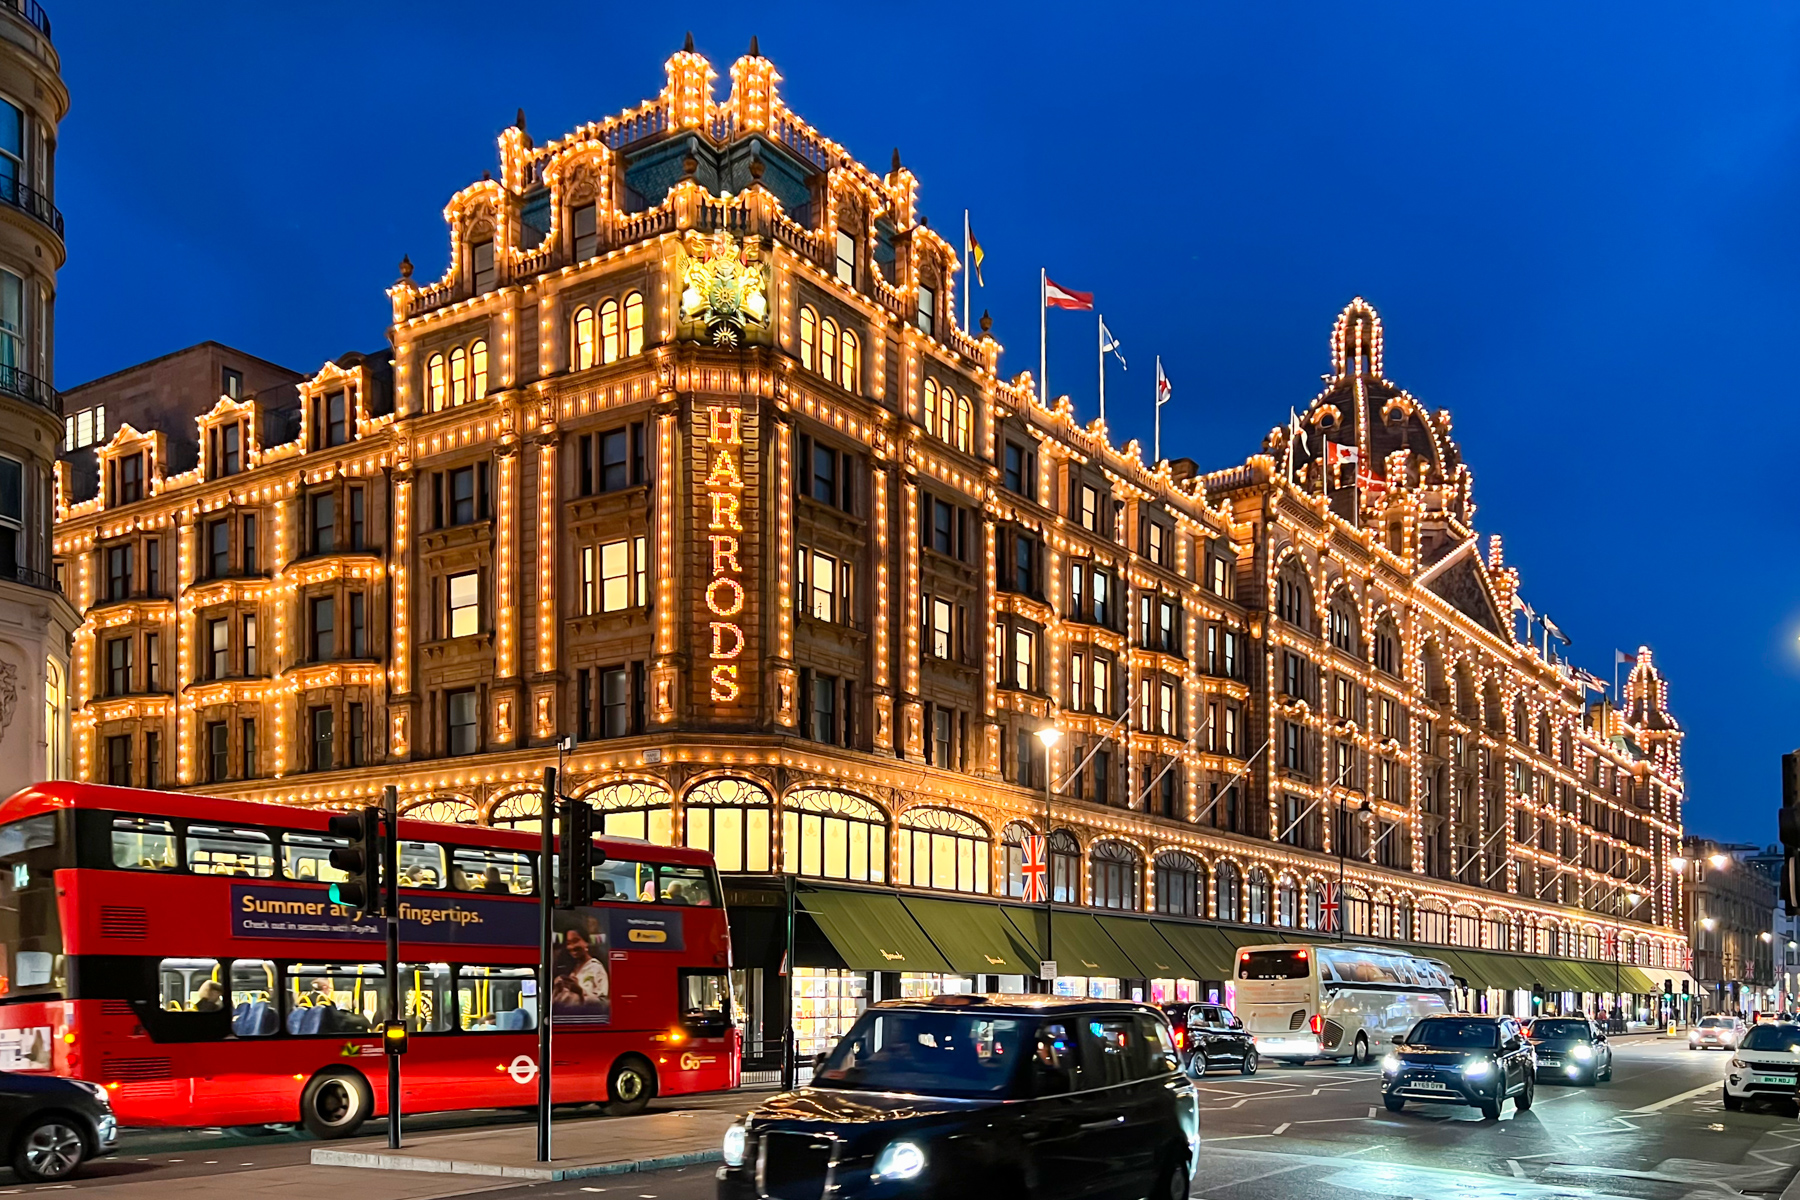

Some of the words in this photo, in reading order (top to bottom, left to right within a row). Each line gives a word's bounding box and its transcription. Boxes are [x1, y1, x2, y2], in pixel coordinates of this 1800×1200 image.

[705, 405, 745, 702] HARRODS
[242, 895, 325, 915] Summer
[330, 904, 348, 917] at
[398, 903, 483, 927] fingertips.
